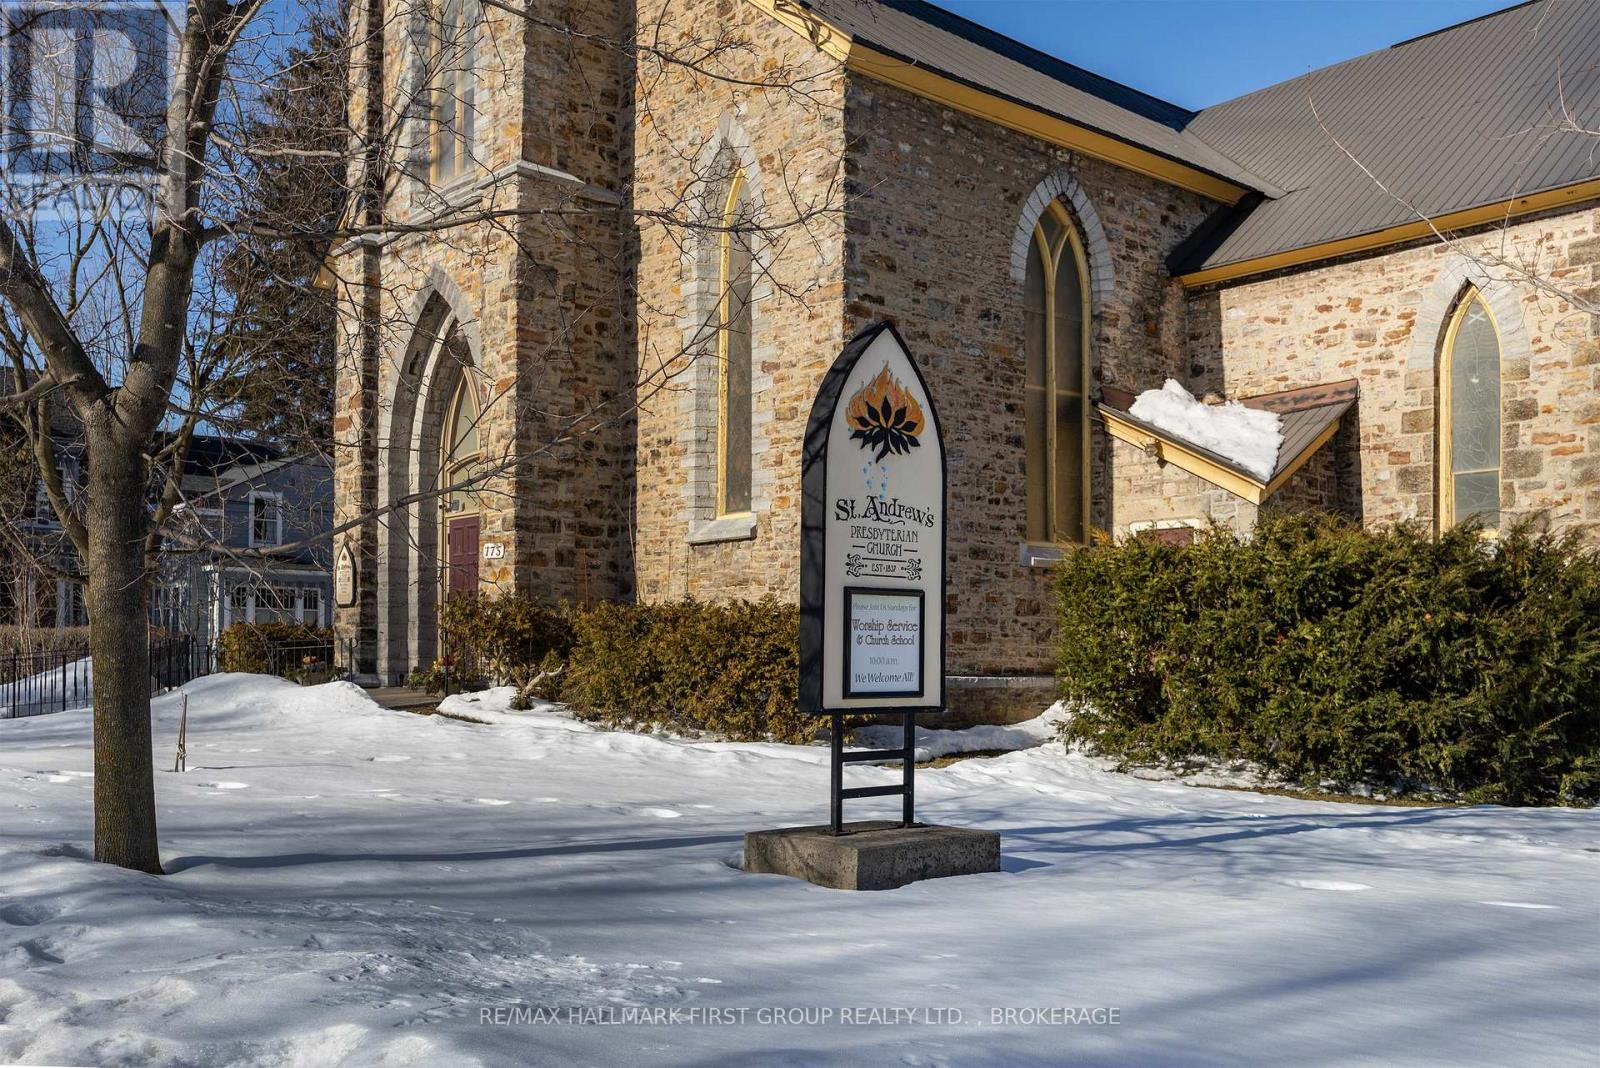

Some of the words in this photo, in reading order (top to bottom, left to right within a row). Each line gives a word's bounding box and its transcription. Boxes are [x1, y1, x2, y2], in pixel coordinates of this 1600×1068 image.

[835, 498, 861, 521] St.
[862, 495, 934, 528] Andrew's
[850, 525, 919, 543] PRESBYTERIAN
[485, 546, 502, 557] 175
[866, 541, 902, 557] CHURCH
[852, 619, 884, 635] Worship
[887, 619, 918, 631] Service
[857, 635, 863, 645] &
[865, 635, 889, 645] Church
[891, 635, 914, 645] School
[855, 673, 867, 683] We
[868, 672, 901, 683] Welcome
